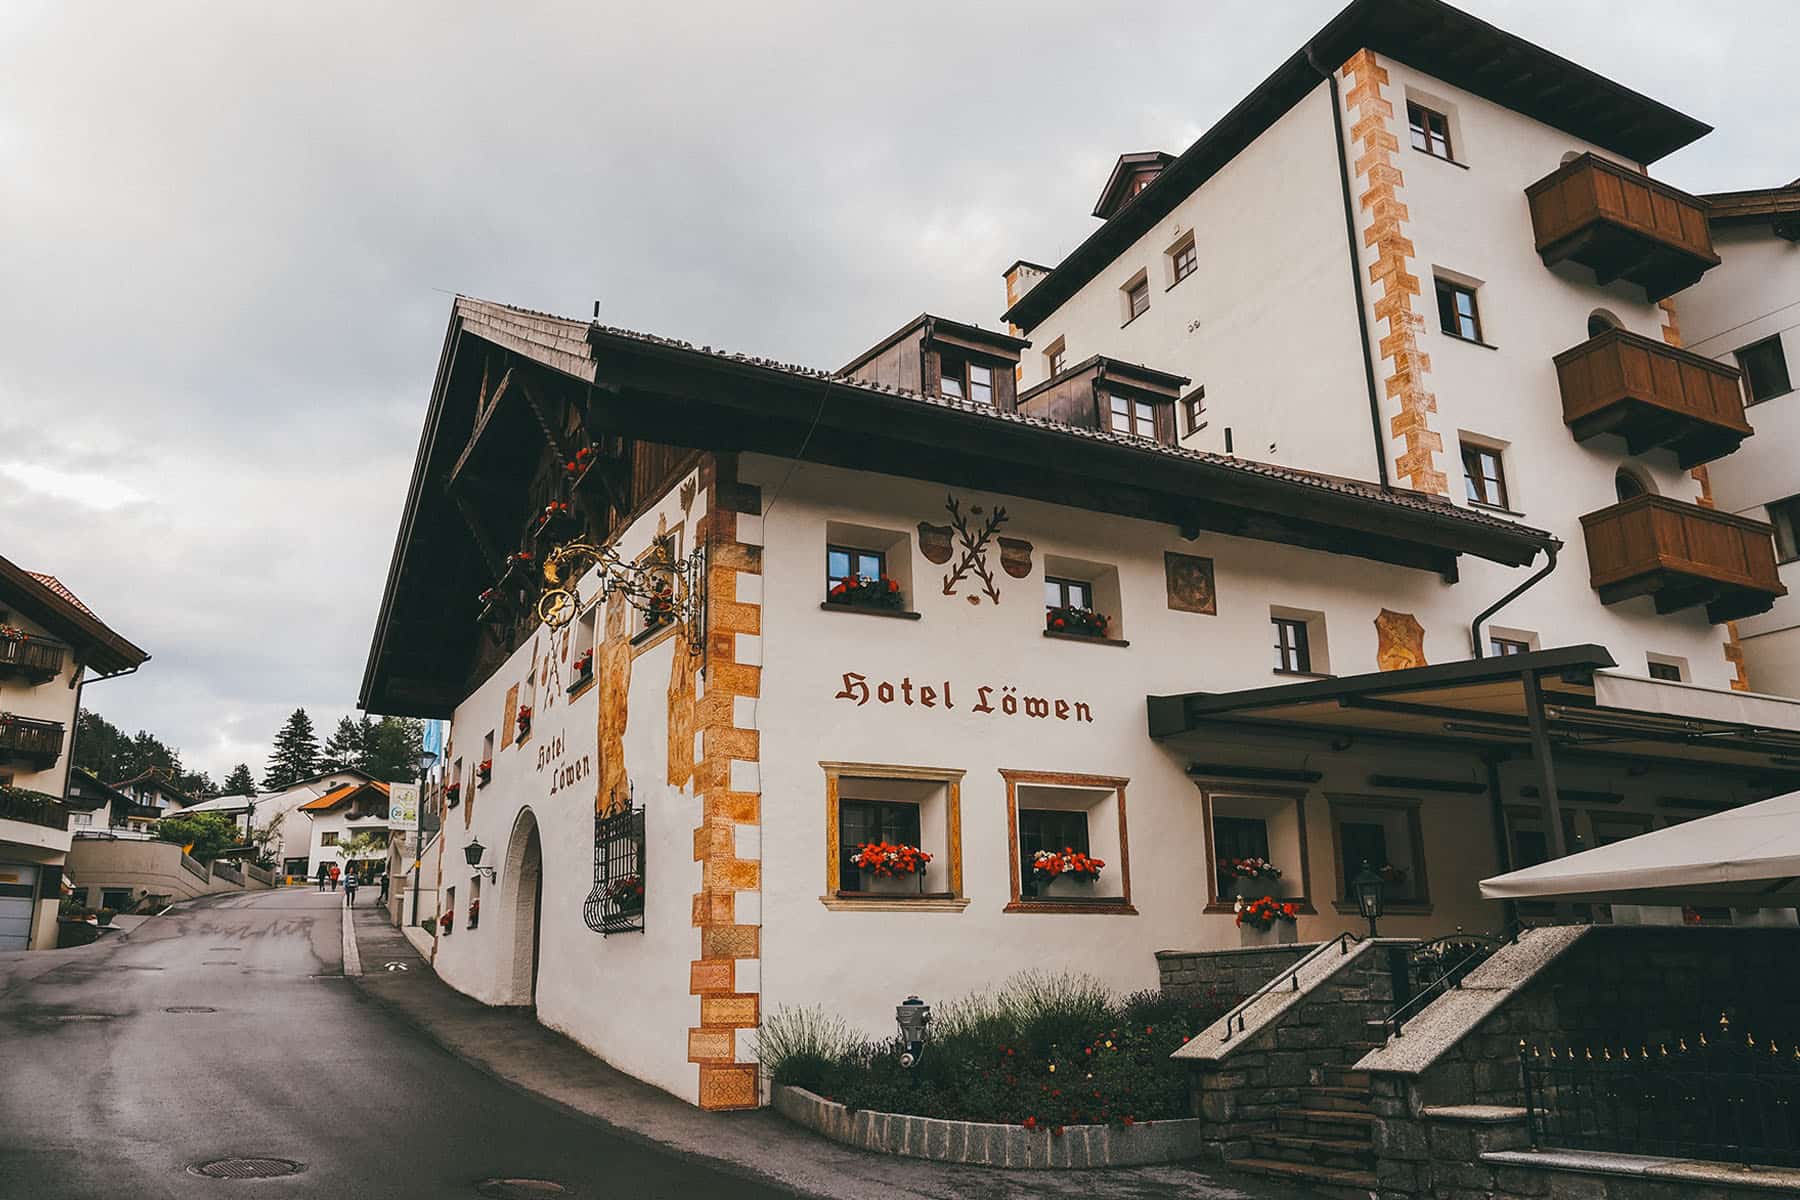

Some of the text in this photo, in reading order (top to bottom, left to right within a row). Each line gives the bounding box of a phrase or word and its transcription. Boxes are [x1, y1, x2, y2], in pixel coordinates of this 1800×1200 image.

[835, 672, 1094, 723] Hotel Löwen
[536, 728, 565, 772] Hotel
[550, 755, 590, 796] Löwen
